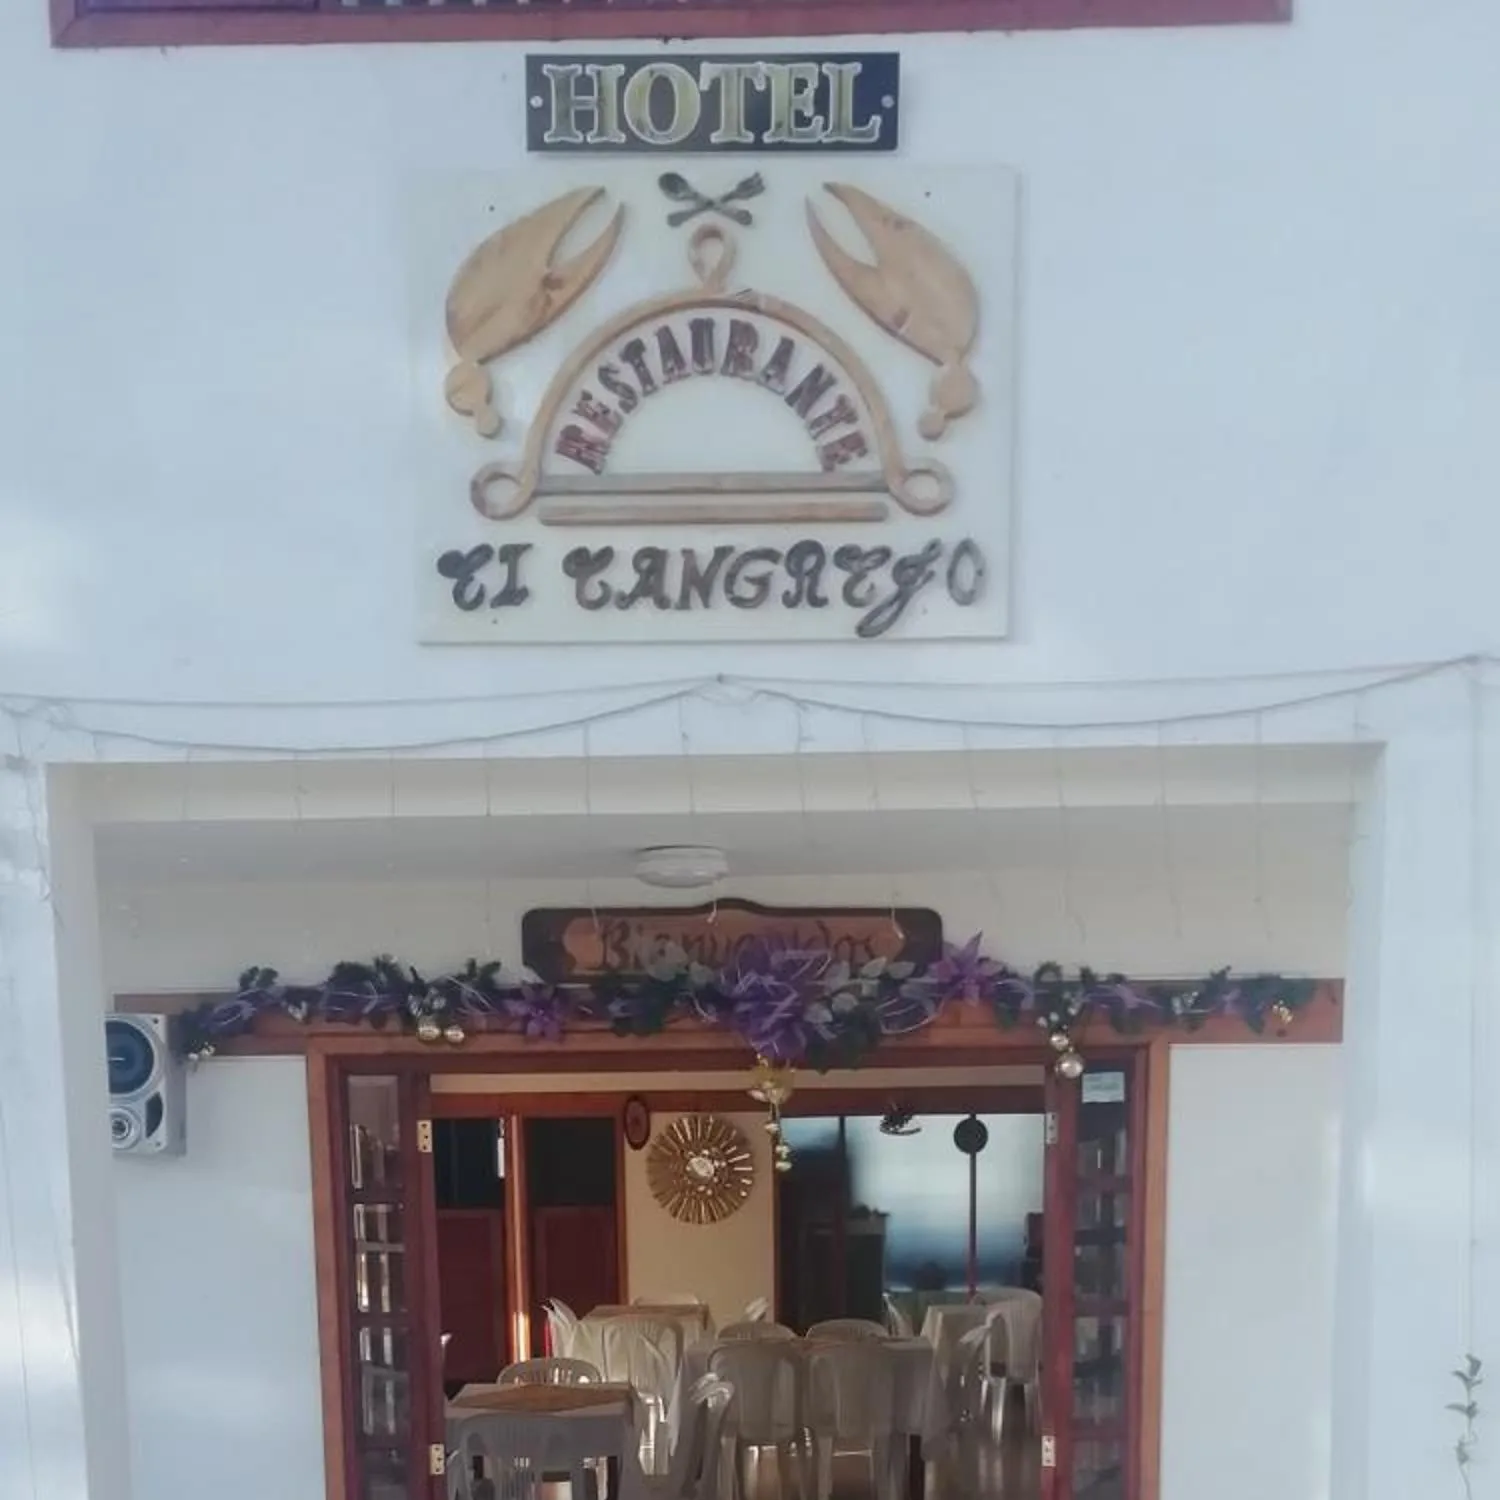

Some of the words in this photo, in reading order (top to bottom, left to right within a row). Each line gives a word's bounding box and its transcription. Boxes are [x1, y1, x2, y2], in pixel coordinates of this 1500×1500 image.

[543, 61, 882, 144] HOTEL
[556, 317, 868, 475] RESTAURANTE
[562, 538, 987, 638] CANGREJO
